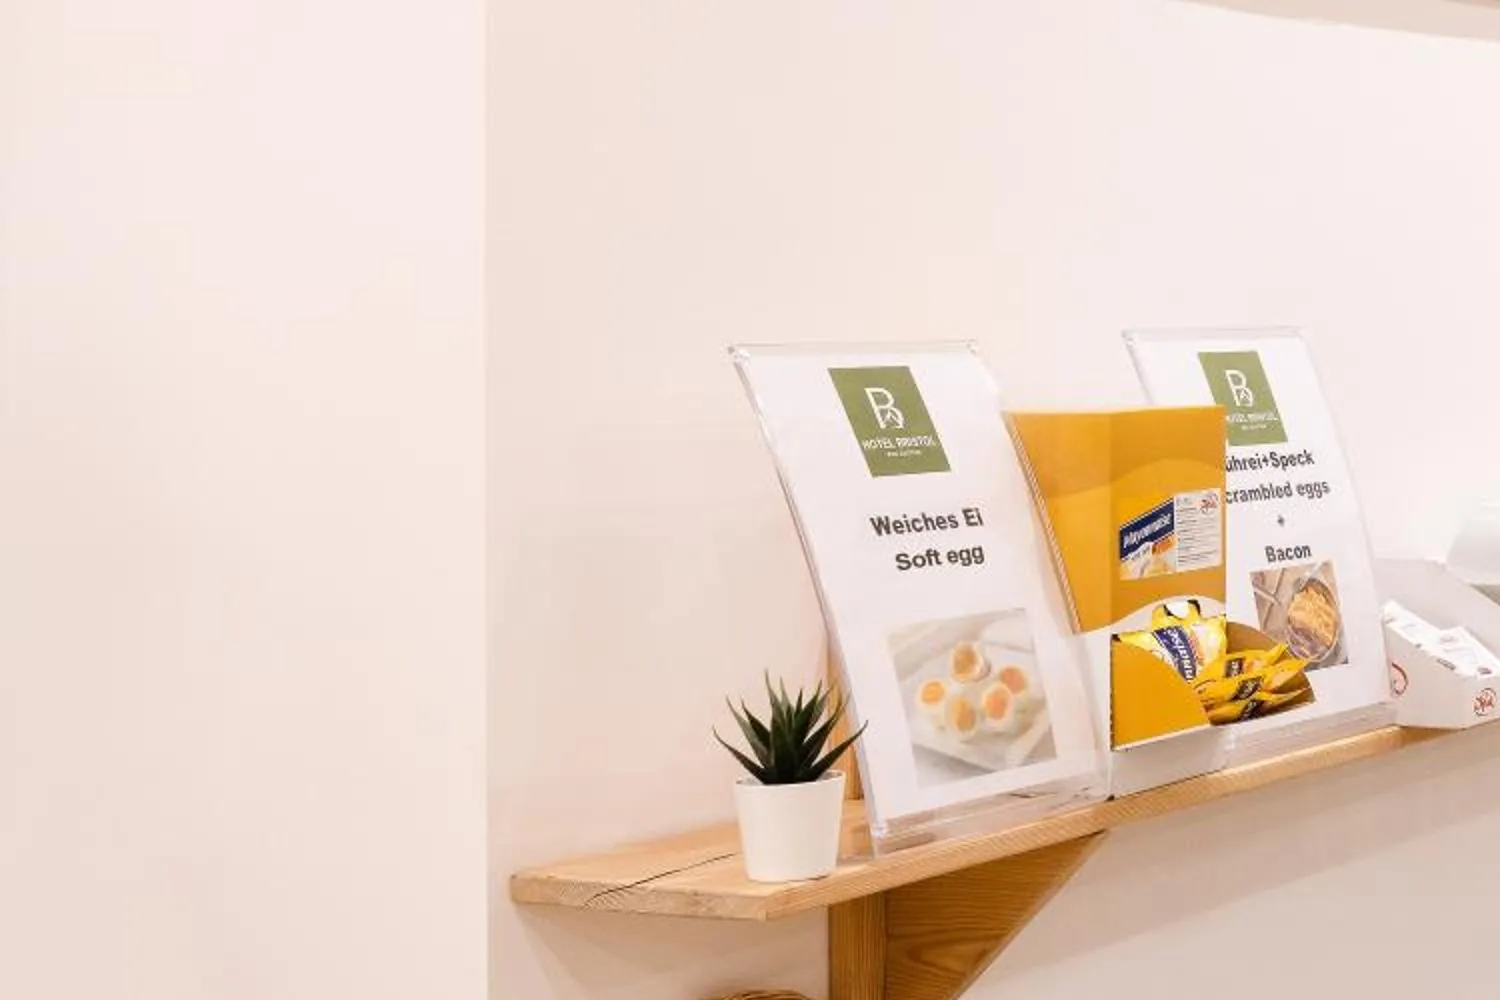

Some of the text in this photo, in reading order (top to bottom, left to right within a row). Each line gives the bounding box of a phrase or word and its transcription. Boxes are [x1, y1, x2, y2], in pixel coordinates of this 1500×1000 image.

[1225, 449, 1314, 472] ührei+Speck
[1225, 482, 1293, 505] crambled
[1295, 480, 1331, 499] eggs
[869, 507, 985, 536] Weiches Ei
[895, 545, 985, 571] Soft egg
[1264, 545, 1312, 563] Bacon
